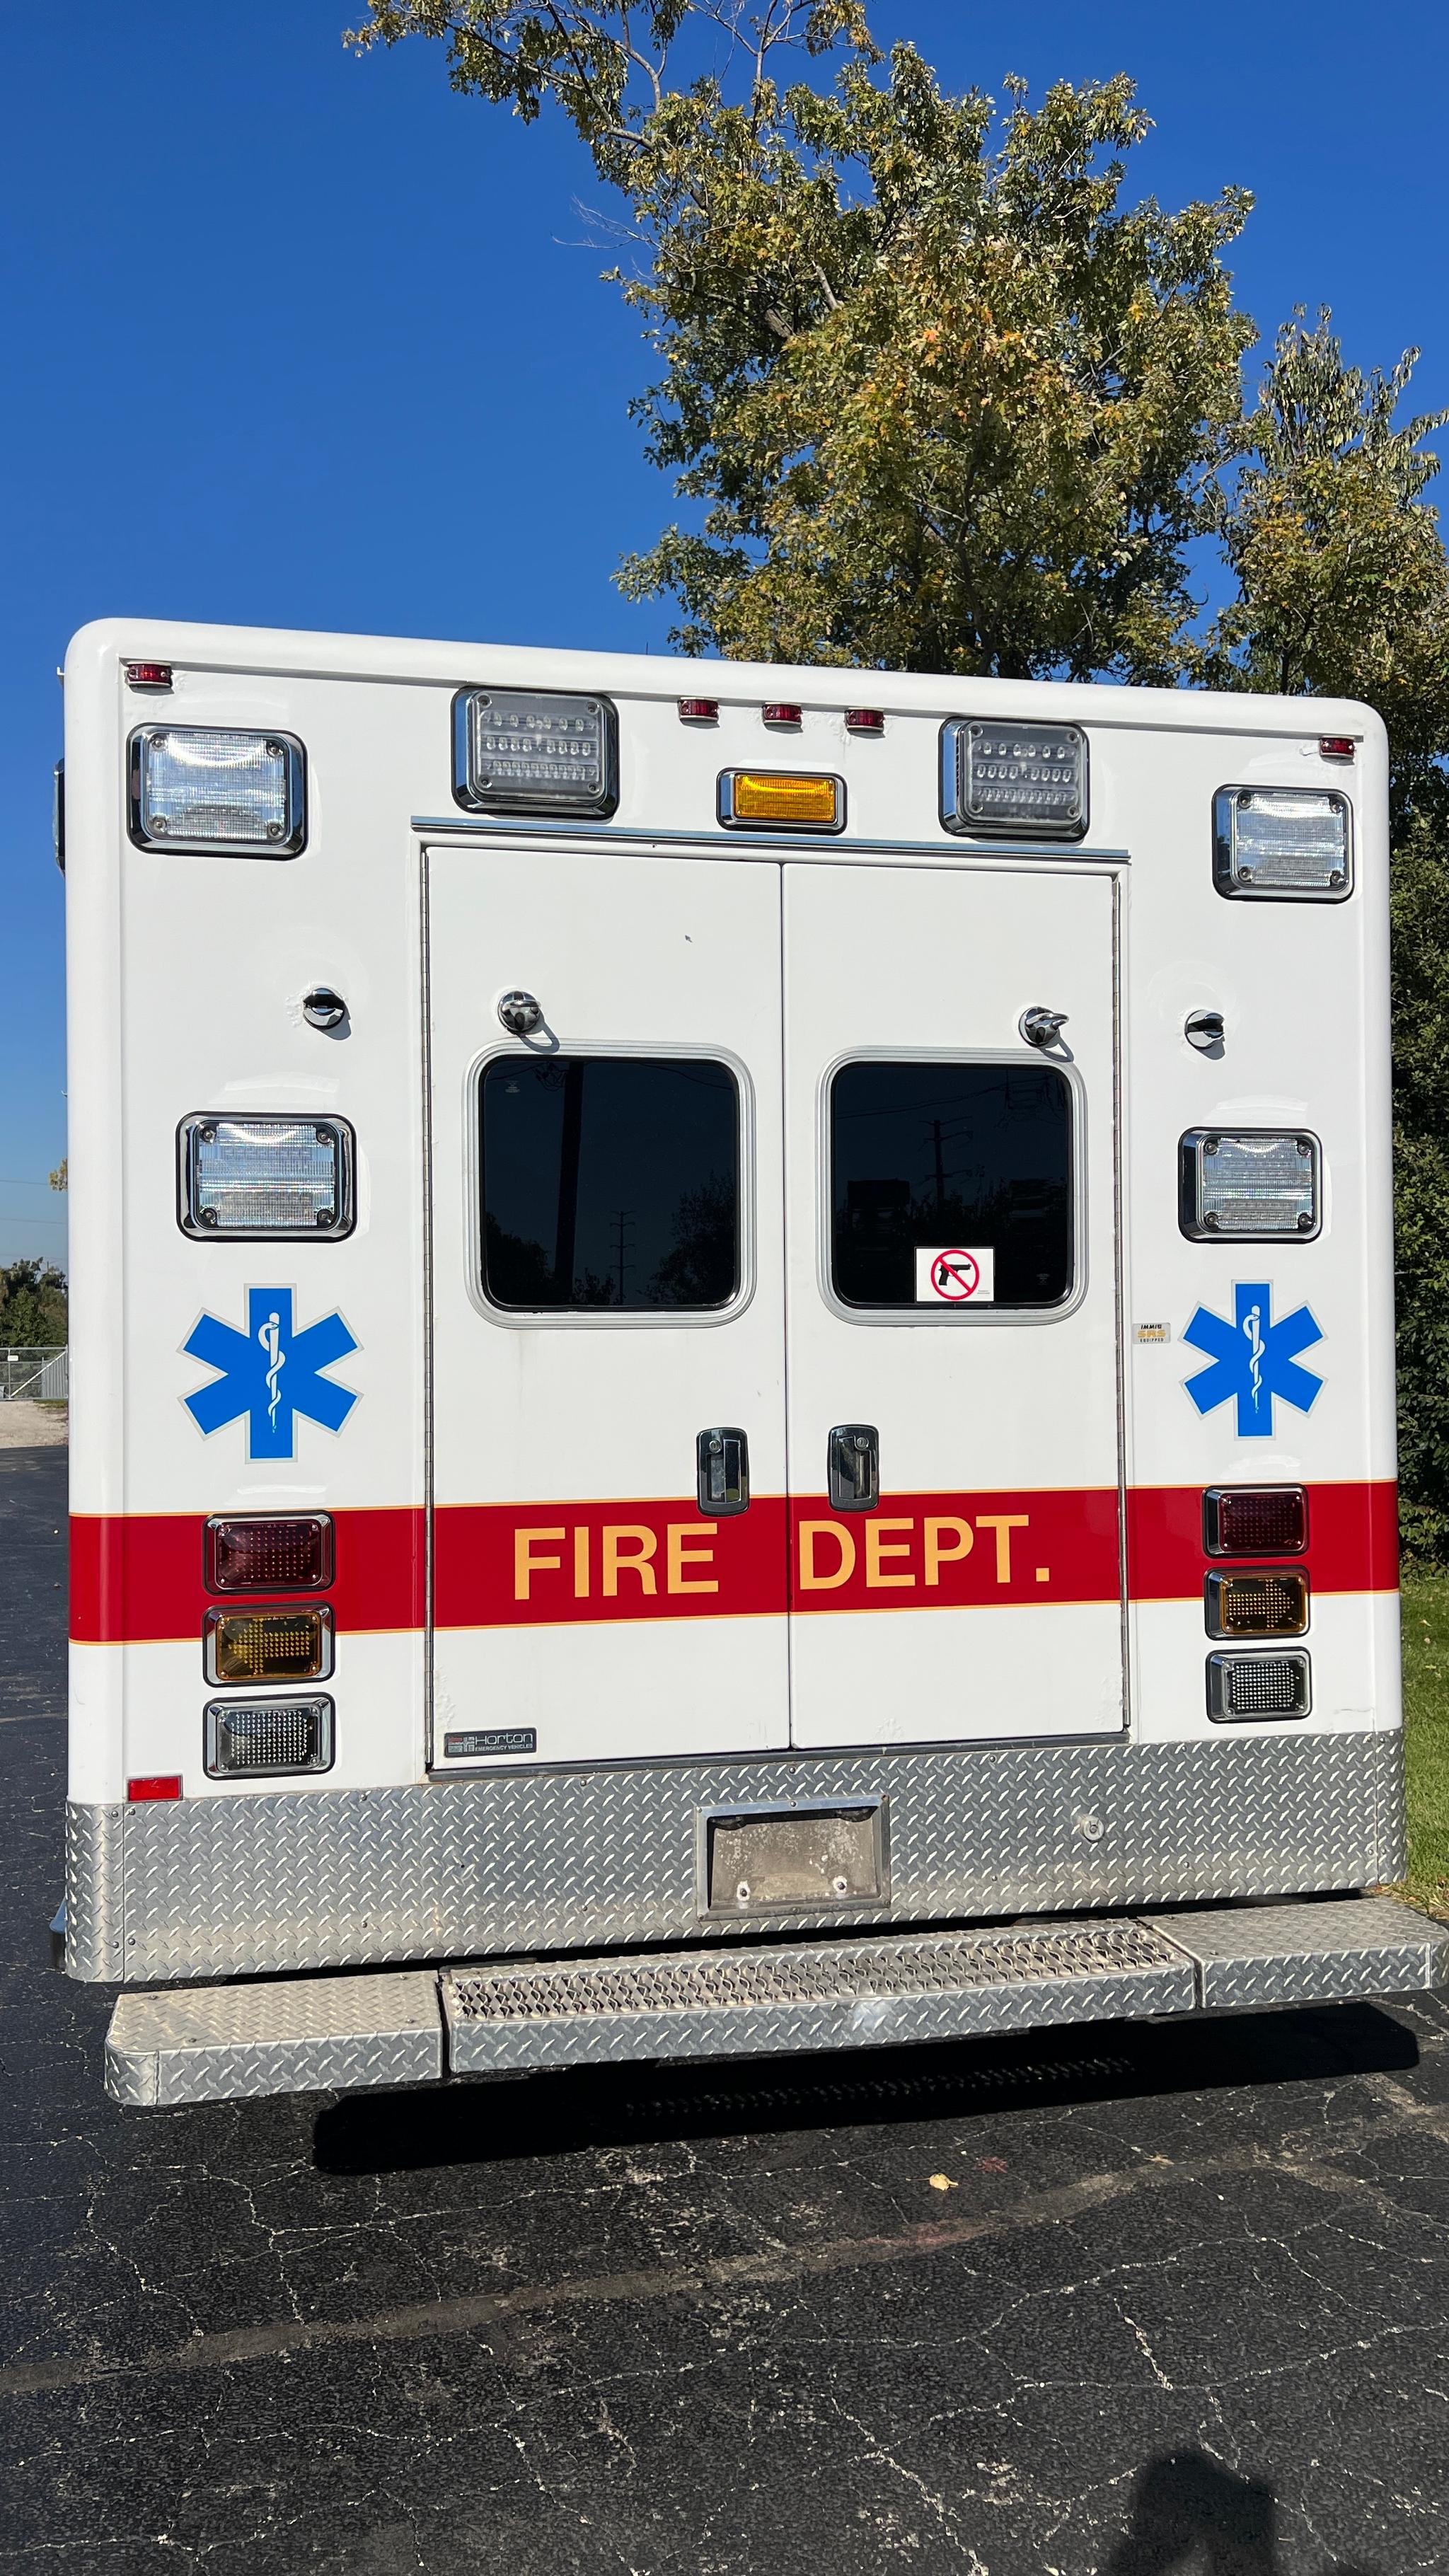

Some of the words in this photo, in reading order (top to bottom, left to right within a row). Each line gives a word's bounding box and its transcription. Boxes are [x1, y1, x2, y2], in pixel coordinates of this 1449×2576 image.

[514, 1523, 719, 1600] FIRE
[799, 1515, 1049, 1590] DEPT.
[475, 1733, 533, 1745] Horton
